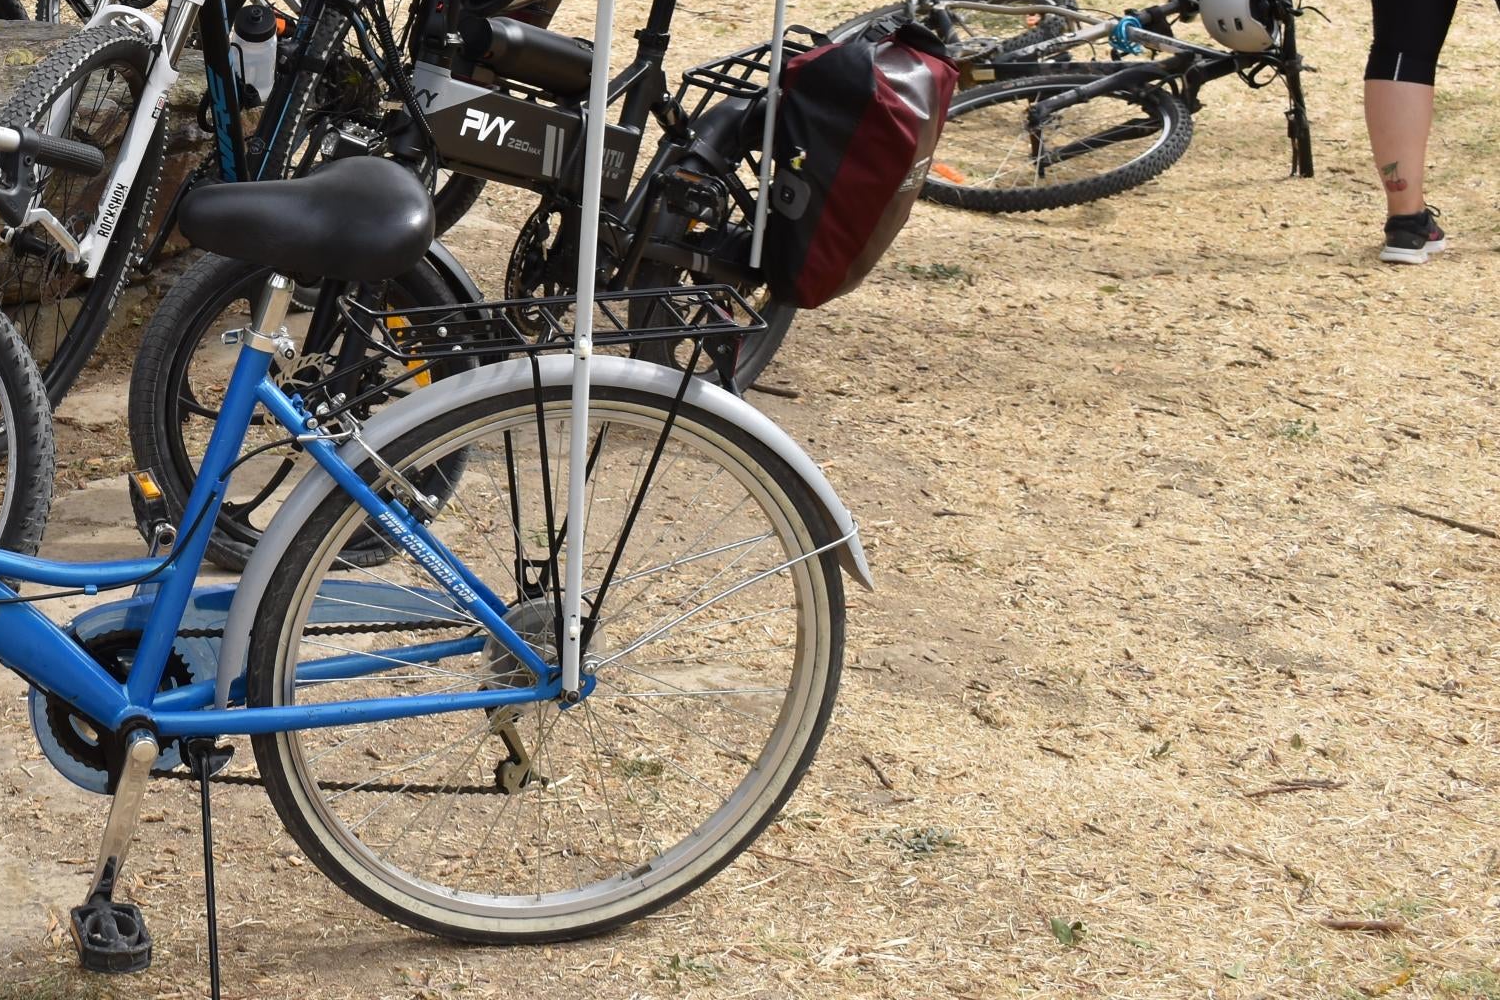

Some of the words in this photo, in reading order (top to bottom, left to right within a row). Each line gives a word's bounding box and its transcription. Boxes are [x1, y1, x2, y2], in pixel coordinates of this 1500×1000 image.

[459, 108, 516, 147] PVY
[97, 182, 129, 239] ROCKSHOX
[137, 186, 154, 231] SAM
